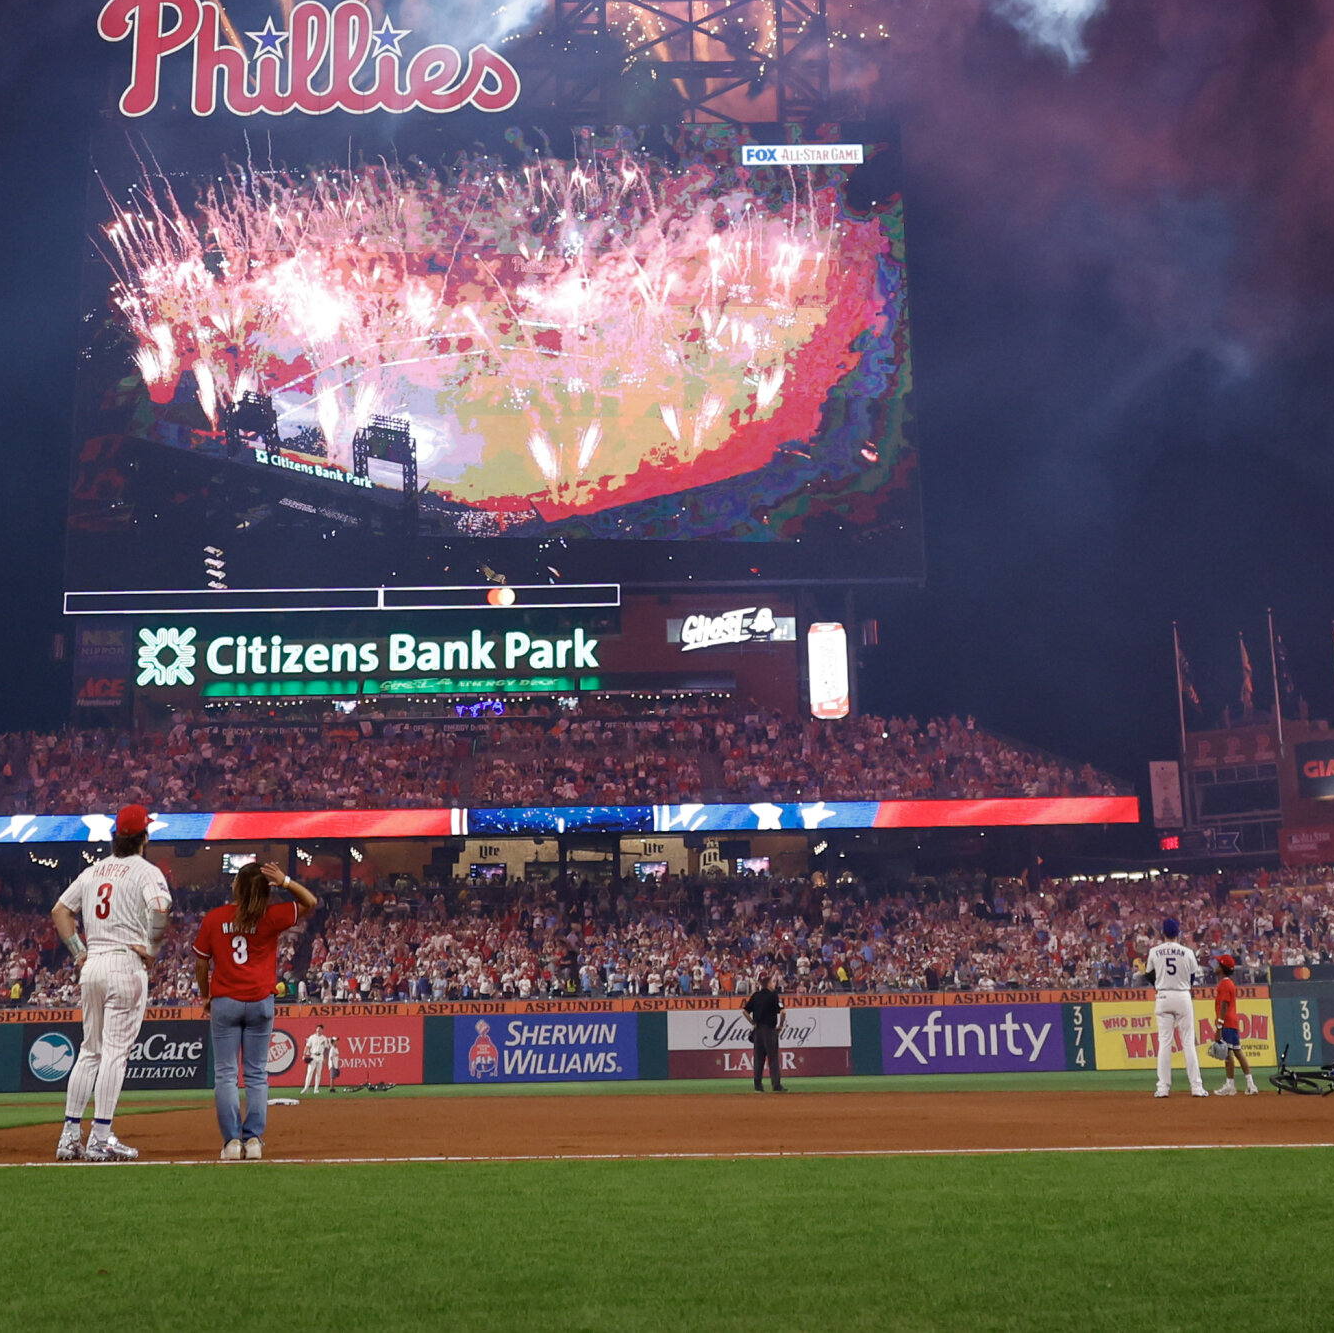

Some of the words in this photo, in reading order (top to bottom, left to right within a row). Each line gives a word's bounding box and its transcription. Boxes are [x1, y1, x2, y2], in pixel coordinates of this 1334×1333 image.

[746, 148, 777, 162] FOX
[831, 148, 859, 161] GAME
[270, 454, 313, 475] Citizens
[314, 464, 344, 482] Bank
[346, 472, 372, 488] Park
[206, 634, 379, 675] Citizens
[389, 629, 497, 671] Bank
[505, 628, 599, 669] Park
[78, 677, 126, 698] ACE
[479, 845, 500, 859] Lite
[643, 842, 664, 857] Lite
[92, 864, 131, 879] HARPER
[95, 883, 113, 919] 3
[231, 936, 248, 965] 3
[1155, 948, 1186, 958] FREEMAN
[1166, 957, 1177, 976] 5
[846, 995, 934, 1006] ASPLUNDH
[954, 992, 1041, 1004] ASPLUNDH
[1060, 990, 1147, 1001] ASPLUNDH
[309, 1005, 398, 1016] ASPLUNDH
[417, 1003, 505, 1015] ASPLUNDH
[525, 1001, 613, 1012] ASPLUNDH
[632, 999, 720, 1011] ASPLUNDH
[1102, 1018, 1127, 1029] WHO
[1130, 1016, 1152, 1028] BUT
[505, 1021, 617, 1047] SHERWIN
[893, 1011, 1052, 1065] xfinity
[347, 1035, 411, 1055] WEBB
[503, 1049, 619, 1074] WILLIAMS
